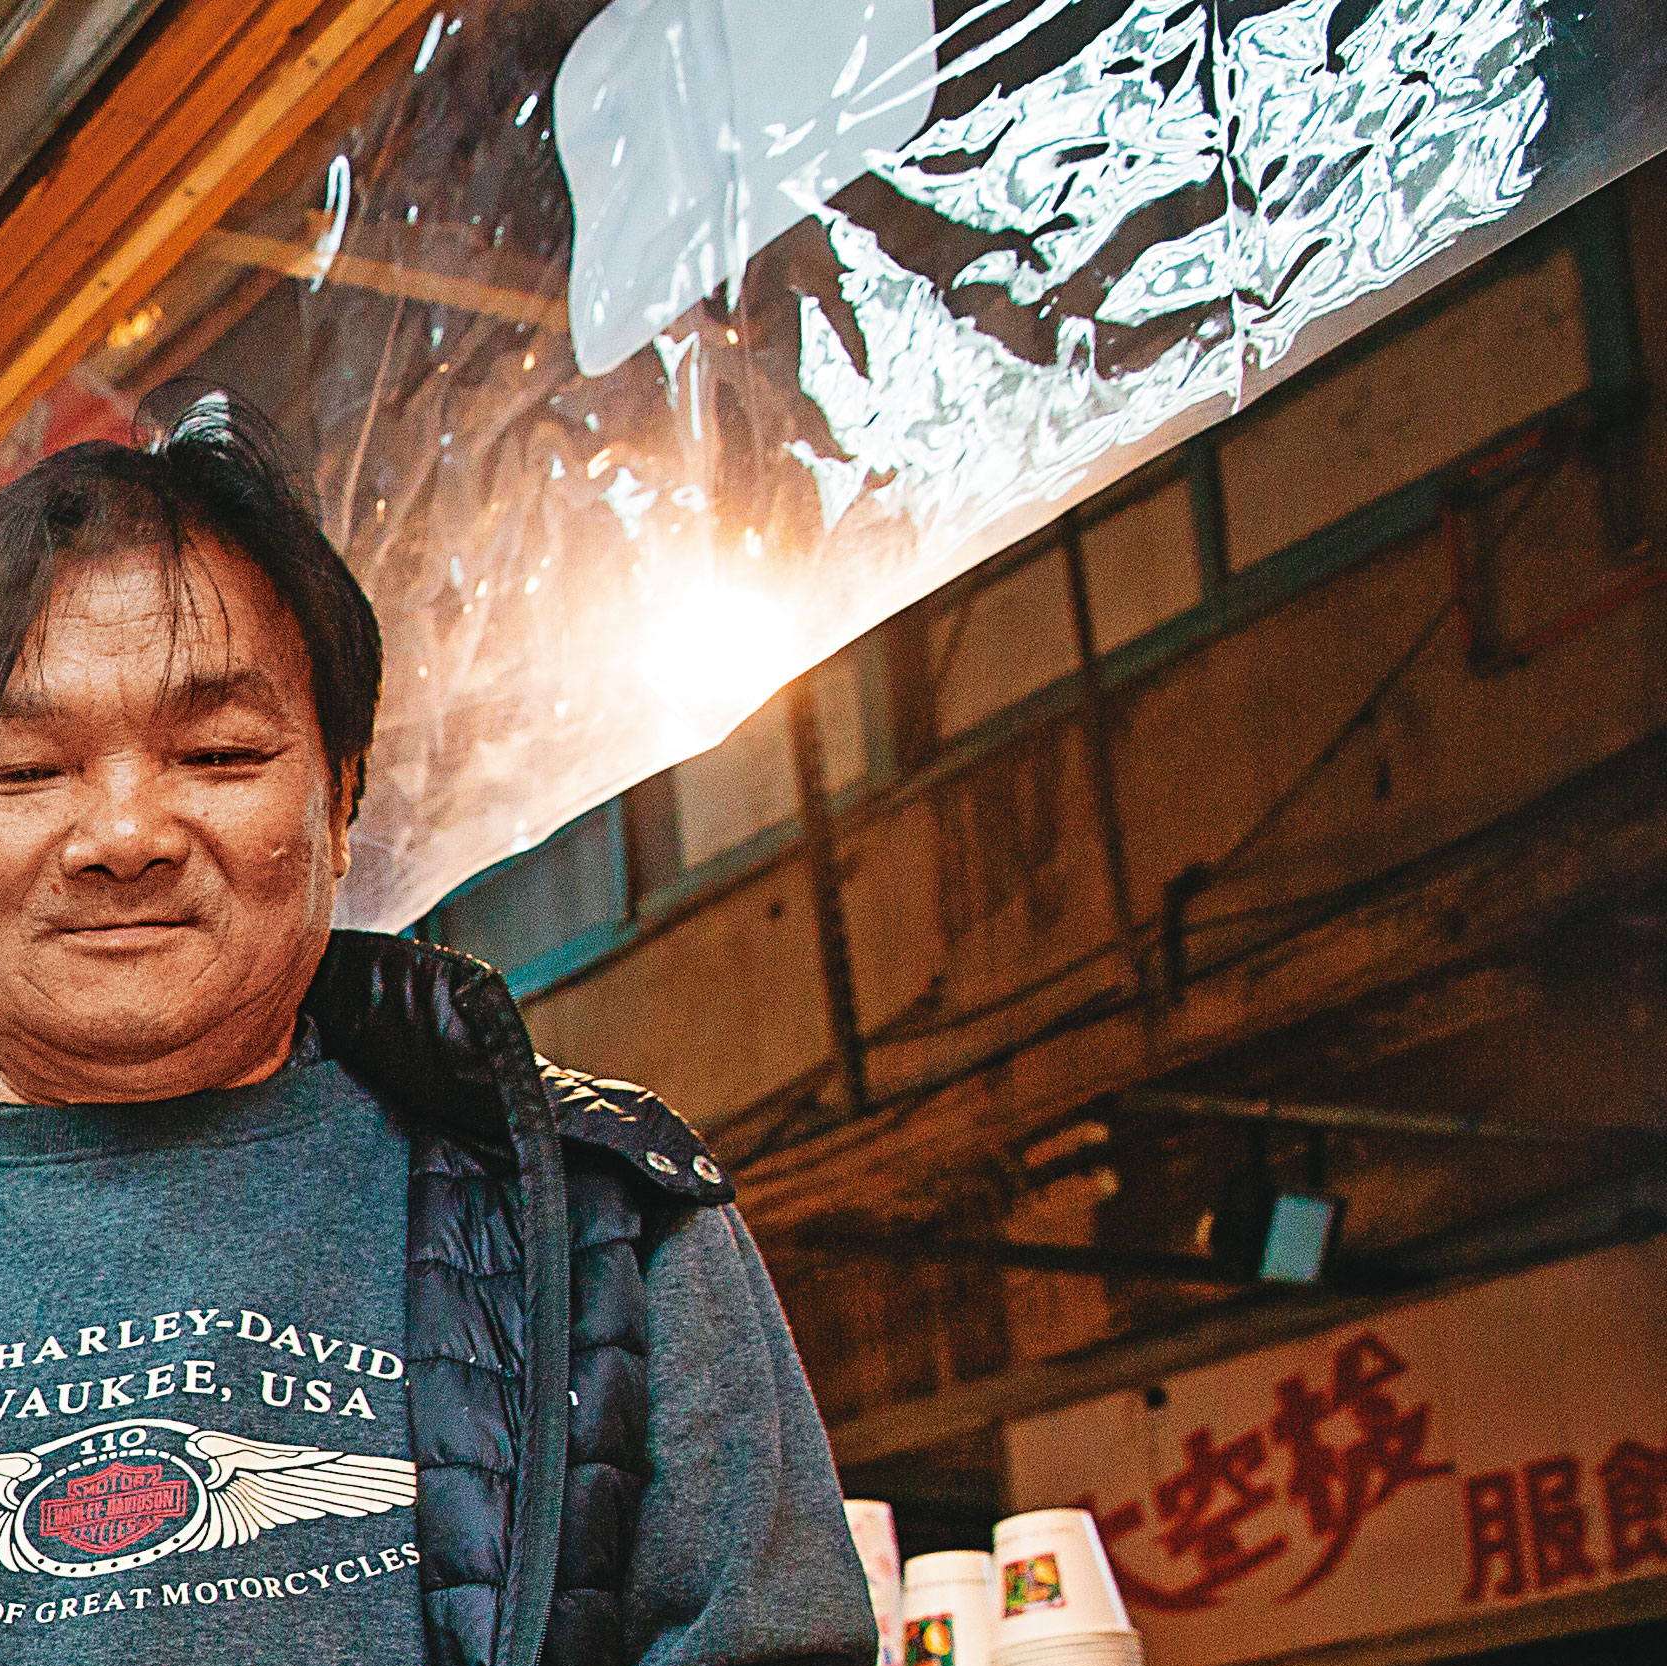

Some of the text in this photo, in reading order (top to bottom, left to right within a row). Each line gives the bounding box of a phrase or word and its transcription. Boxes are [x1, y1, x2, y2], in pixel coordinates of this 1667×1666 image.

[260, 1370, 377, 1420] USA
[79, 1427, 147, 1455] 110
[81, 1471, 146, 1498] MOTOR
[53, 1487, 175, 1526] HARLEY-DAVIDSON
[77, 1517, 137, 1545] CYCLES
[34, 1586, 152, 1624] GREAT
[161, 1541, 421, 1607] MOTORCYCLES
